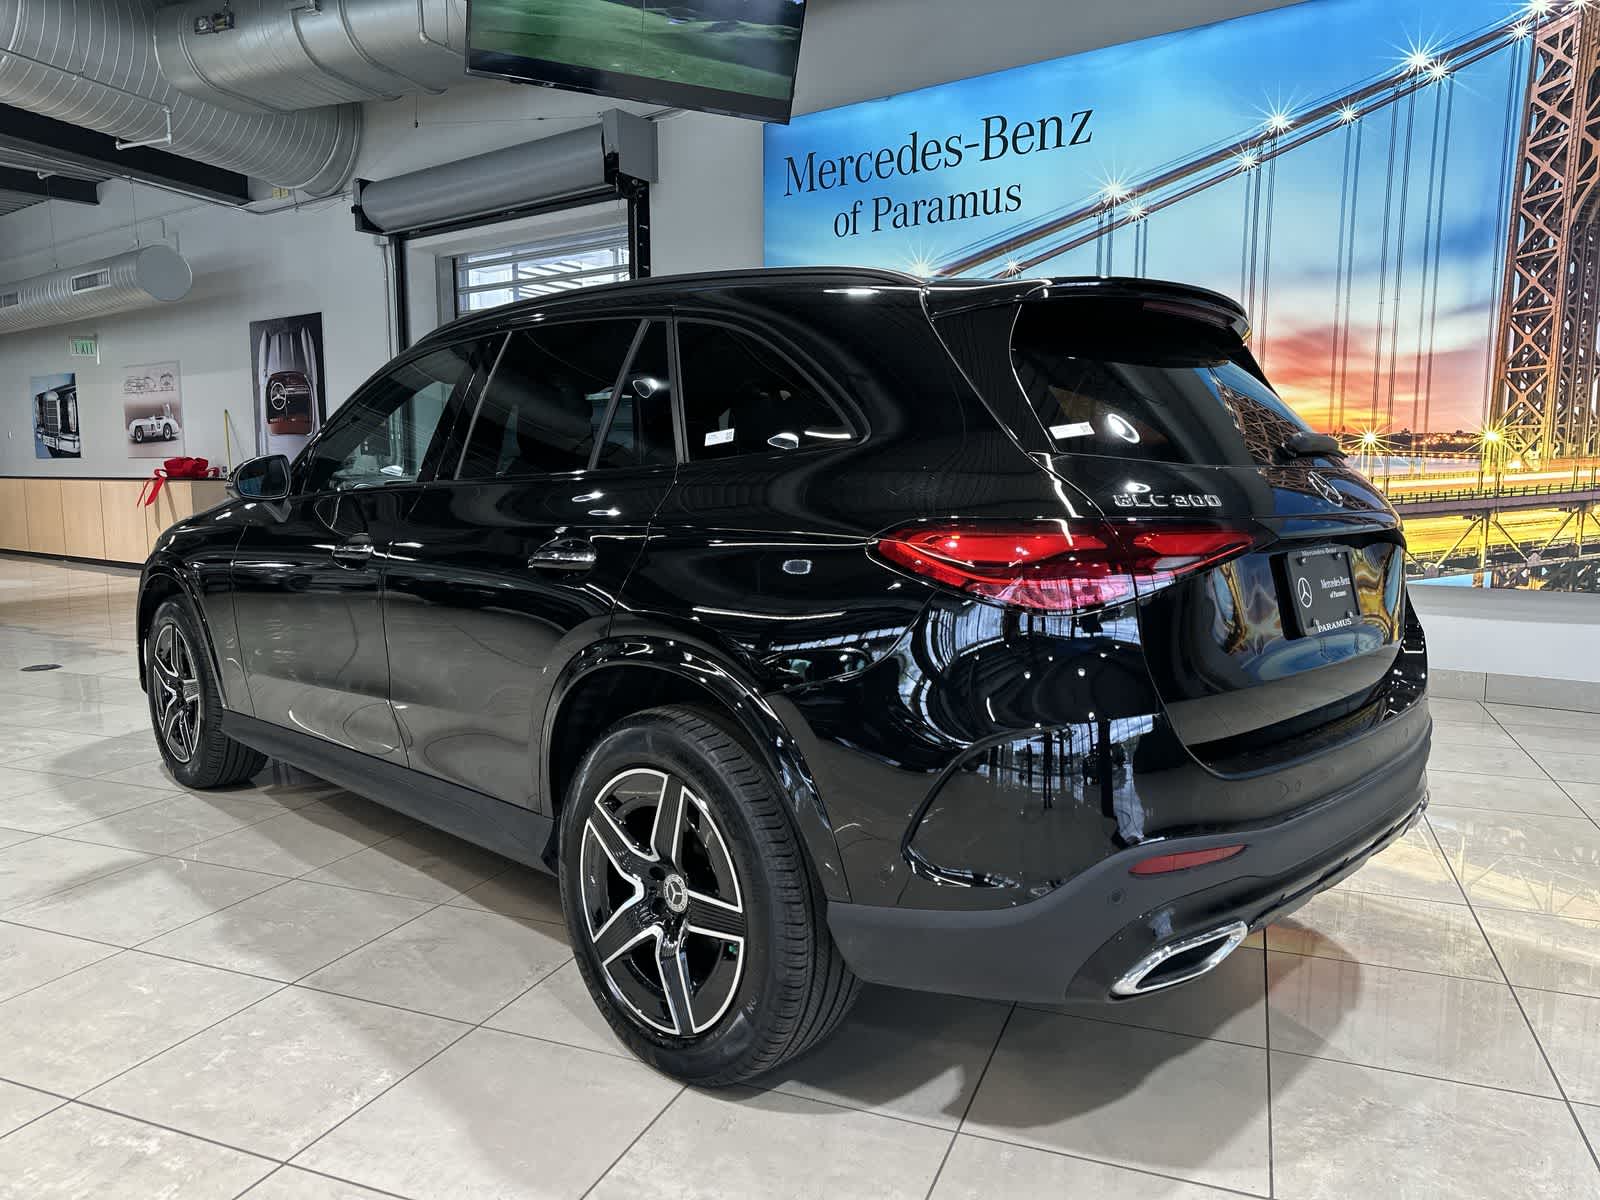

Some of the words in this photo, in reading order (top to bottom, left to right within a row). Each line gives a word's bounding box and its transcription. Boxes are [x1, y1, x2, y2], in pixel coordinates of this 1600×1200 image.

[783, 108, 1094, 197] Mercedes-Benz
[833, 199, 863, 238] of
[871, 183, 1022, 233] Paramus
[1112, 493, 1168, 507] GLC
[1171, 493, 1222, 507] 300
[1318, 618, 1352, 632] PARAMUS
